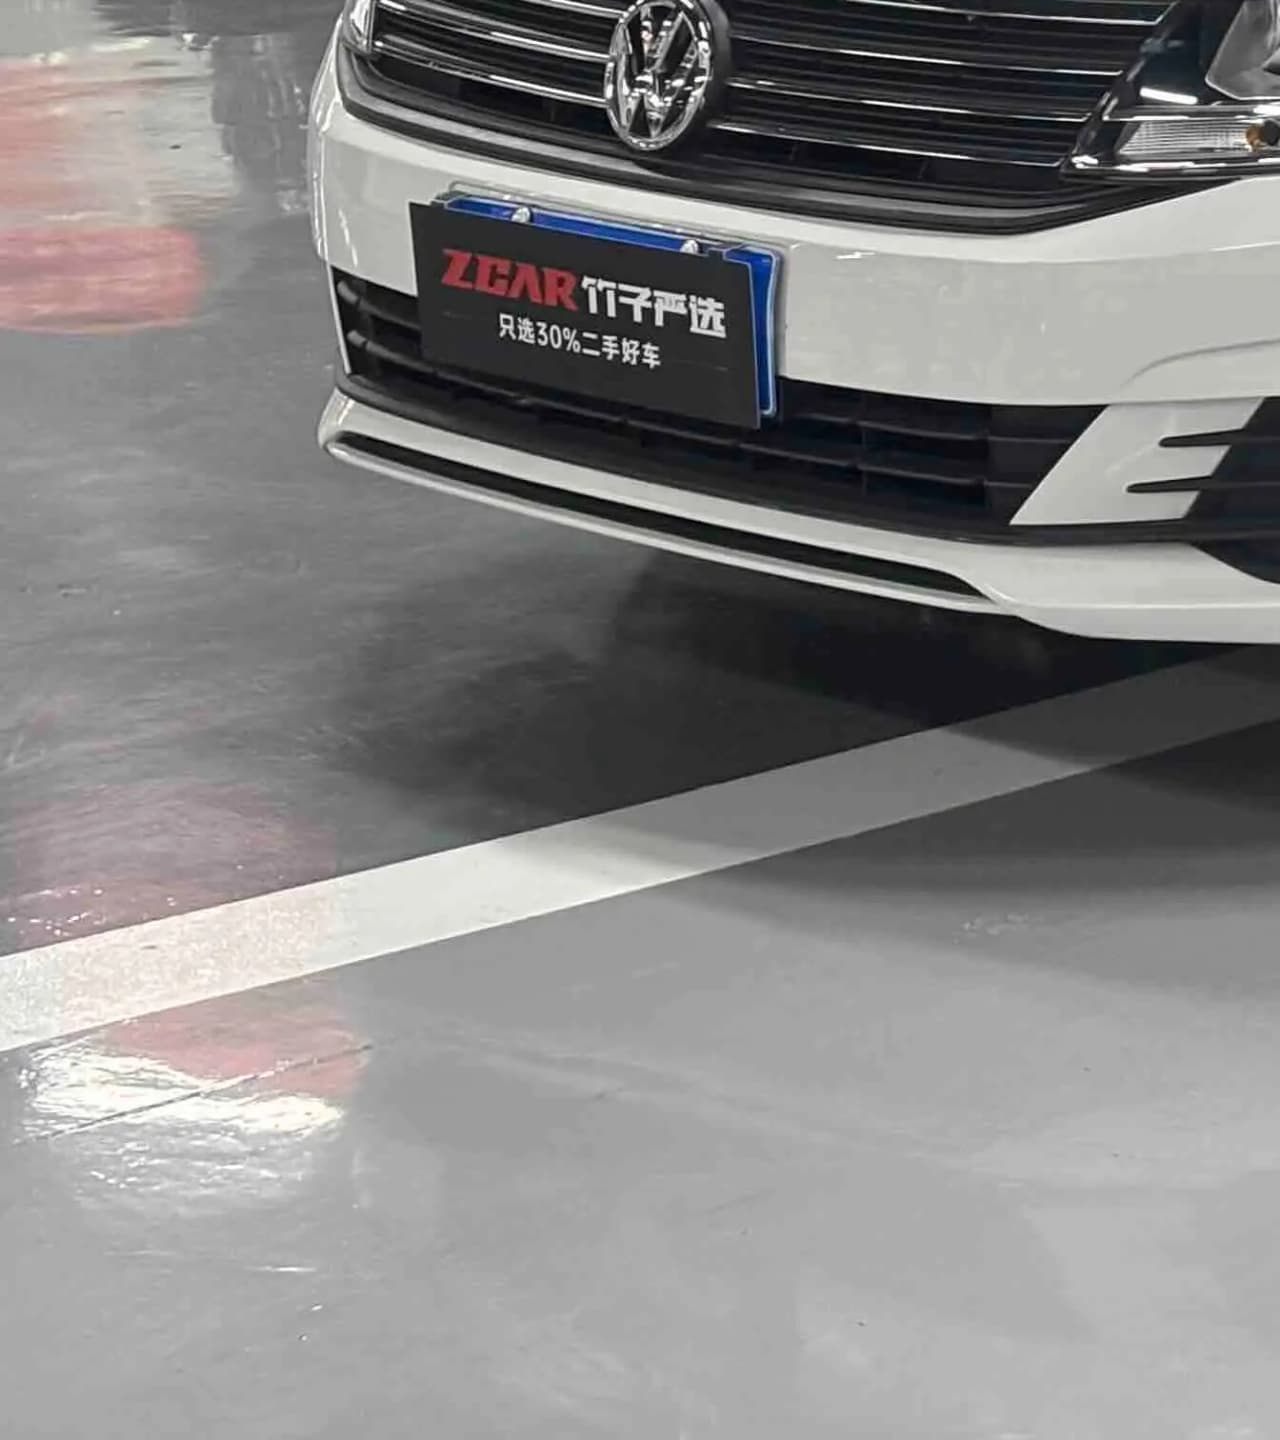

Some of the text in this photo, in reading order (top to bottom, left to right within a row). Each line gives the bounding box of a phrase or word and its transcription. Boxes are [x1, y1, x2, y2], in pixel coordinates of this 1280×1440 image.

[499, 313, 662, 370] 只选30%二手好车
